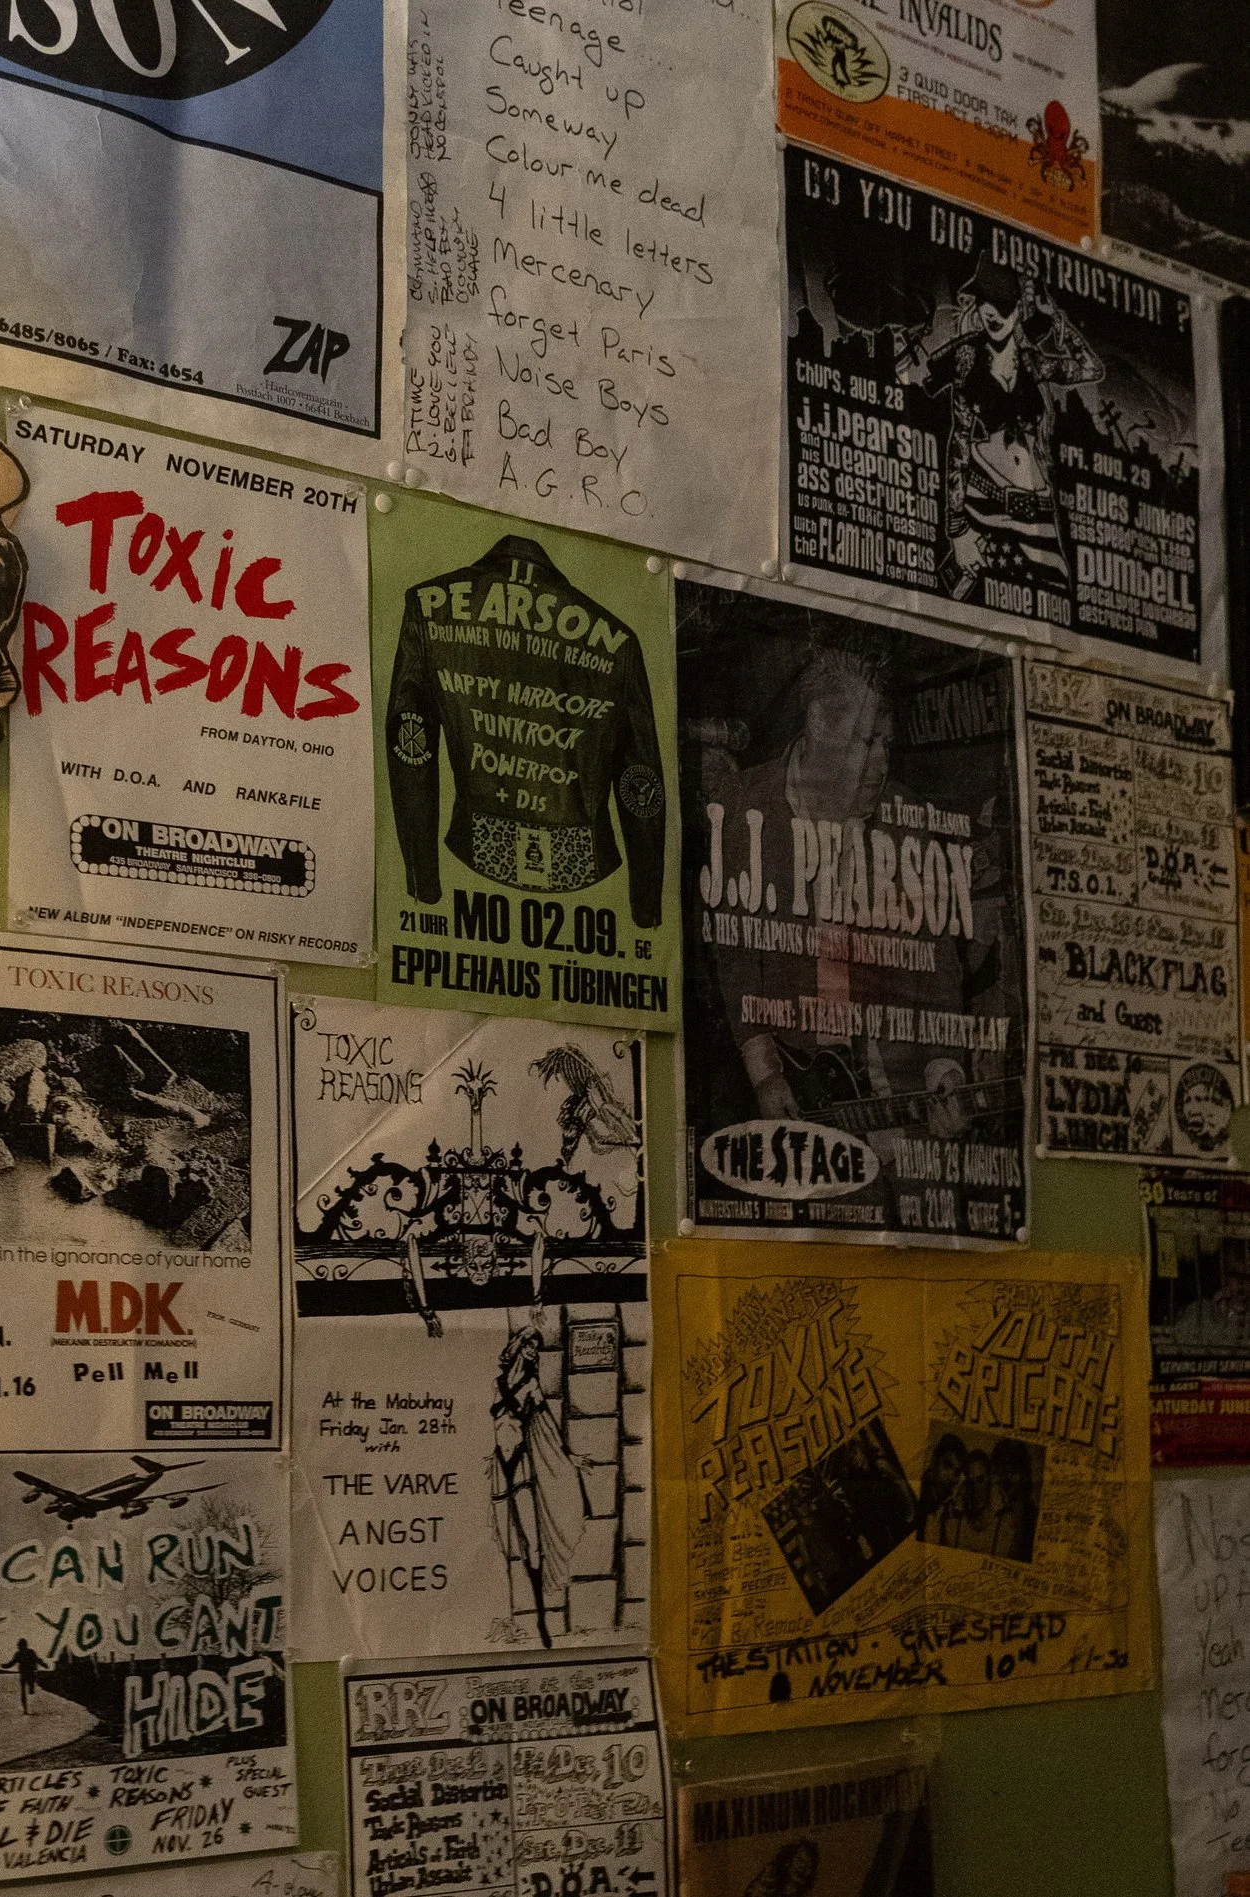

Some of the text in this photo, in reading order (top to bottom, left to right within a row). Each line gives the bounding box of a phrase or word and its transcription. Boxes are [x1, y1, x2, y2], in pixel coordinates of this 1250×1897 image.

[489, 34, 584, 96] Caught
[485, 85, 618, 161] Someway
[485, 134, 706, 228] Colour me dead
[488, 180, 715, 284] 4 little letters
[493, 236, 655, 320] Mercenary
[158, 361, 205, 386] 4654
[262, 315, 351, 386] ZAP
[601, 326, 676, 378] Paris
[495, 344, 670, 428] Noise Boys
[884, 384, 904, 412] 28
[497, 399, 628, 473] Bad Boy
[14, 419, 358, 515] SATURDAY NOVEMBER 20TH
[508, 559, 538, 588] J.J.
[416, 581, 630, 655] PEARSON
[21, 601, 361, 722] REASONS
[495, 627, 616, 676] VON TOXIC REASONS
[400, 711, 424, 725] DEAD
[436, 668, 616, 722] HAPPY HARDCORE
[199, 725, 335, 758] FROM DAYTON, OHIO
[469, 707, 586, 751] PUNKROCK
[60, 760, 322, 812] WITH D.O.A. AND RANK&FILE
[469, 742, 579, 787] POWERPOP
[102, 817, 288, 860] ON BROADWAY
[700, 802, 975, 941] J.J. PEARSON
[63, 909, 358, 955] ALBUM ON RISKY RECORDS
[399, 888, 626, 959] 21 UHR MO 02.09.
[7, 964, 215, 1006] TOXIC REASONS
[390, 943, 669, 1013] EPPLEHAUS TÜBINGEN
[1064, 941, 1228, 998] BLACK FLAG
[316, 1032, 425, 1106] TOXIC REASONS
[713, 1131, 766, 1184] THE
[766, 1125, 867, 1188] STAGE
[17, 1247, 48, 1264] the
[50, 1248, 143, 1269] ignorance
[164, 1253, 201, 1270] your
[202, 1250, 251, 1269] home
[54, 1279, 195, 1337] M.D.K.
[72, 1362, 125, 1383] Pell
[971, 1306, 1116, 1393] YOUTH
[13, 1376, 37, 1397] 16
[350, 1391, 454, 1417] the Mabuhay
[936, 1347, 1121, 1460] BRIGADE
[181, 1405, 271, 1420] BROADWAY
[319, 1418, 457, 1443] Friday 28th
[364, 1440, 401, 1453] with
[322, 1472, 459, 1496] THE VARVE
[338, 1516, 445, 1546] ANGST
[0, 1540, 125, 1590] CAN
[146, 1522, 257, 1585] RUN
[332, 1563, 448, 1594] VOICES
[35, 1605, 141, 1660] YOU
[123, 1656, 274, 1759] HIDE
[470, 1687, 631, 1725] ON BROADWAY
[108, 1780, 195, 1809] REASONS
[109, 1765, 169, 1784] TOXIC
[19, 1794, 76, 1814] FAITH
[150, 1798, 236, 1831] FRIDAY
[43, 1816, 96, 1846] DIE
[151, 1829, 225, 1855] NOV. 26
[0, 1843, 88, 1870] VALENCIA
